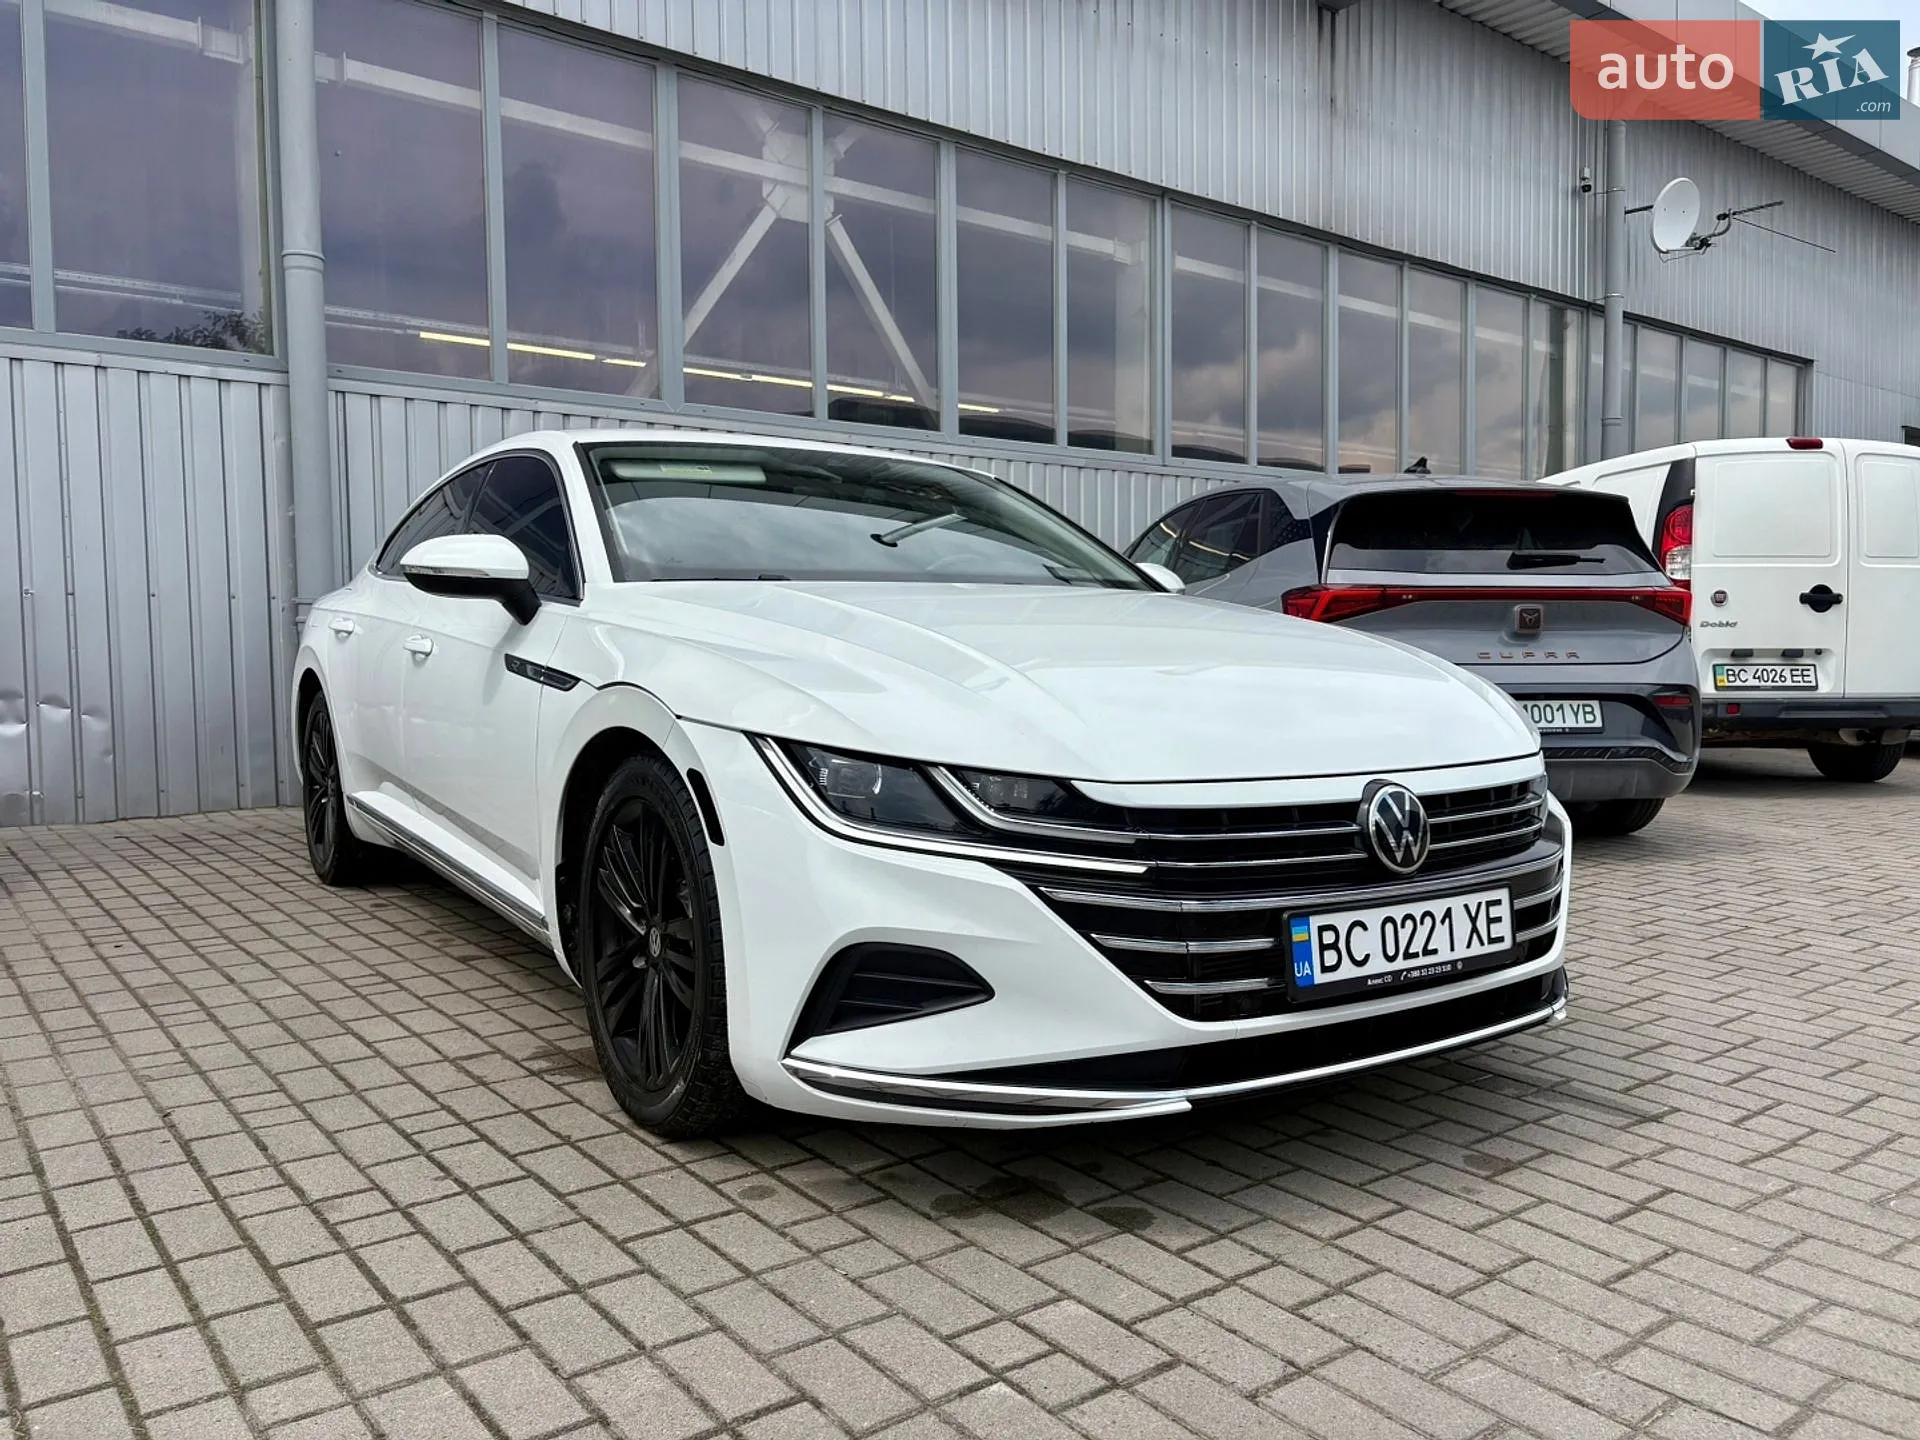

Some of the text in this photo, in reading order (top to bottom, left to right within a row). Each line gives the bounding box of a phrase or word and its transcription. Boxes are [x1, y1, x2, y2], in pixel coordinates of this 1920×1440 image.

[1726, 668, 1812, 683] BC 4026 EE
[1569, 703, 1597, 724] YB
[1317, 898, 1505, 975] BC 0221 XE
[1294, 961, 1312, 977] UA
